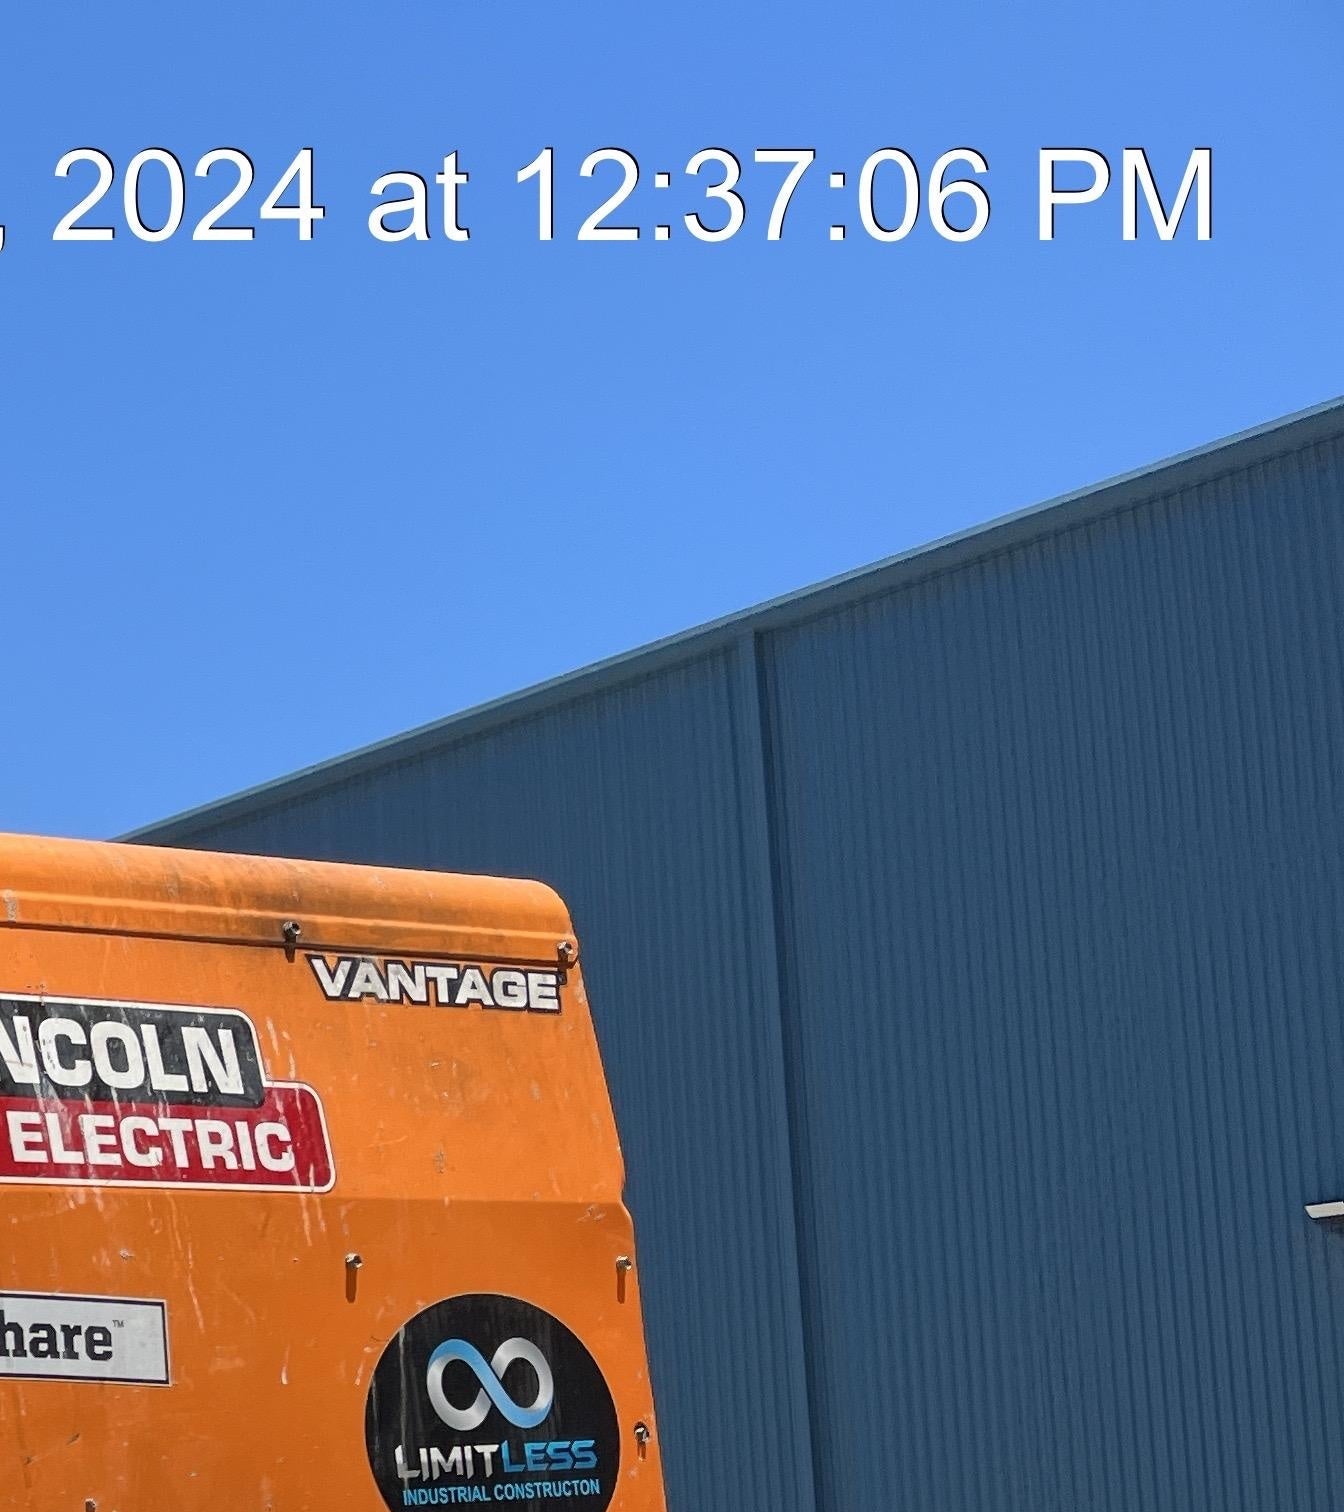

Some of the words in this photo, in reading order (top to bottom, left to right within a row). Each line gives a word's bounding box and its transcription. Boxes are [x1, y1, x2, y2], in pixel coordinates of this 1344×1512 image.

[310, 957, 560, 1011] VANTAGE
[5, 1110, 296, 1173] ELECTRIC
[393, 1439, 597, 1482] LIMITLESS
[403, 1485, 492, 1507] INDUSTRIAL
[494, 1478, 601, 1502] CONSTRUCTON
